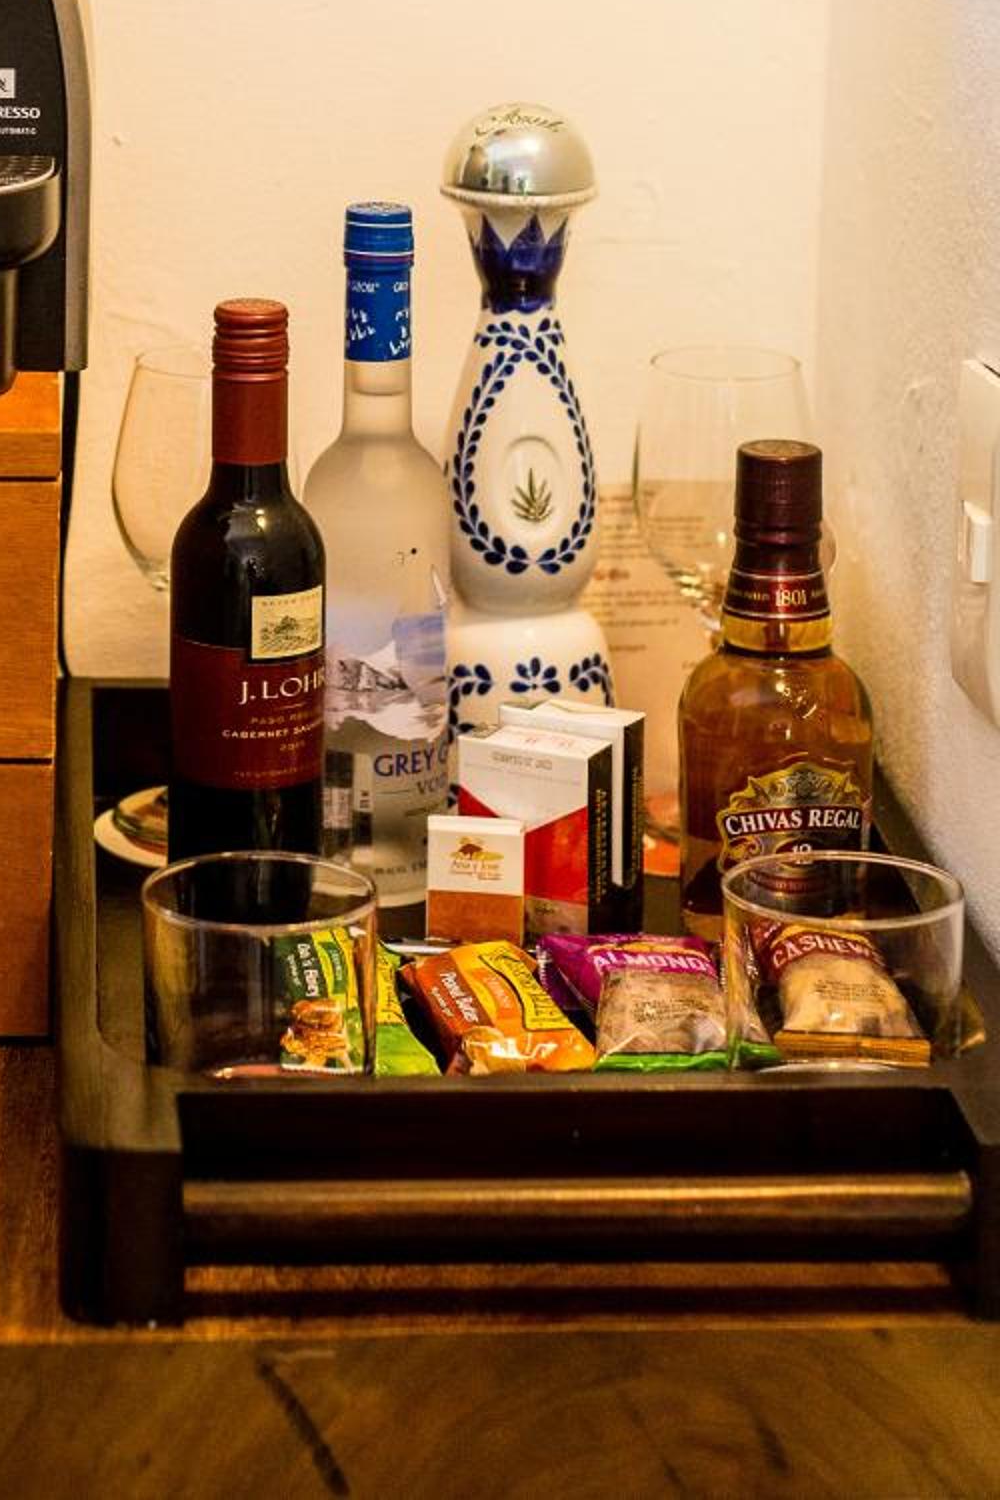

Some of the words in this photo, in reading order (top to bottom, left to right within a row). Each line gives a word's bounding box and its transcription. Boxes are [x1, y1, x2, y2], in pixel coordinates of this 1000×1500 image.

[373, 747, 435, 778] GREY
[725, 809, 803, 836] CHIVAS
[807, 808, 862, 830] REGAL
